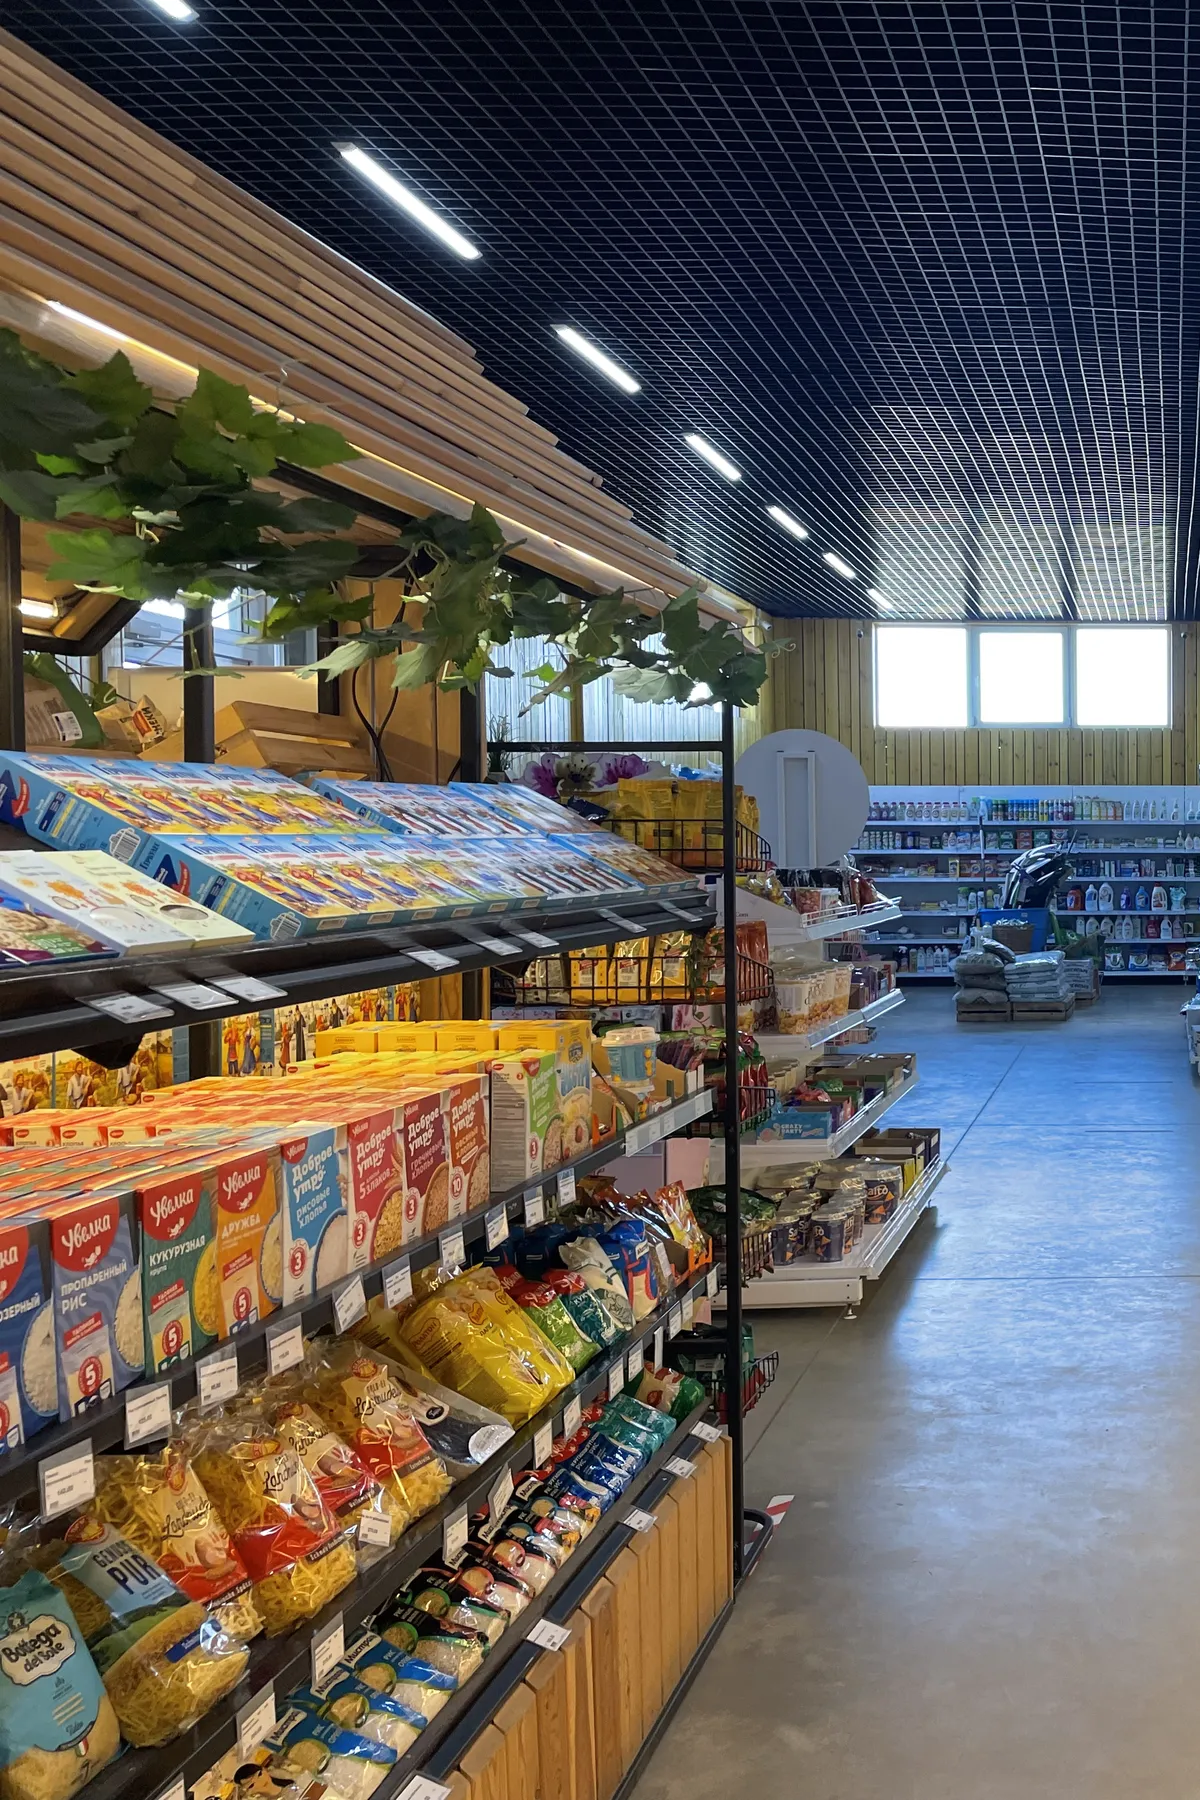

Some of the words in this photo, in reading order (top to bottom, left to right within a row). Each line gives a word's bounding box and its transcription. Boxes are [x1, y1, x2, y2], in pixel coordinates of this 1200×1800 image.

[407, 1107, 440, 1141] Доброе
[356, 1125, 392, 1163] Доброе
[408, 1128, 435, 1157] утро
[292, 1145, 333, 1186] Доброе
[357, 1146, 385, 1178] утро
[222, 1165, 262, 1200] Увелка
[293, 1170, 326, 1203] утро
[150, 1188, 194, 1227] Увелка
[296, 1187, 331, 1221] рисовые
[299, 1201, 328, 1228] хлопья
[408, 1199, 416, 1215] 3
[61, 1214, 111, 1256] Увелка
[221, 1213, 261, 1240] ДРУЖБА
[356, 1223, 365, 1243] 3
[149, 1234, 206, 1267] КУКУРУЗНАЯ
[293, 1251, 303, 1273] 3
[61, 1258, 128, 1297] ПРОПАРЕННЫЙ
[61, 1292, 88, 1315] РИС
[238, 1293, 248, 1312] 5
[168, 1327, 178, 1347] 5
[86, 1364, 97, 1386] 5
[106, 1553, 163, 1596] PUR
[2, 1623, 63, 1664] Bottega
[24, 1656, 43, 1673] del
[41, 1641, 66, 1665] Sole
